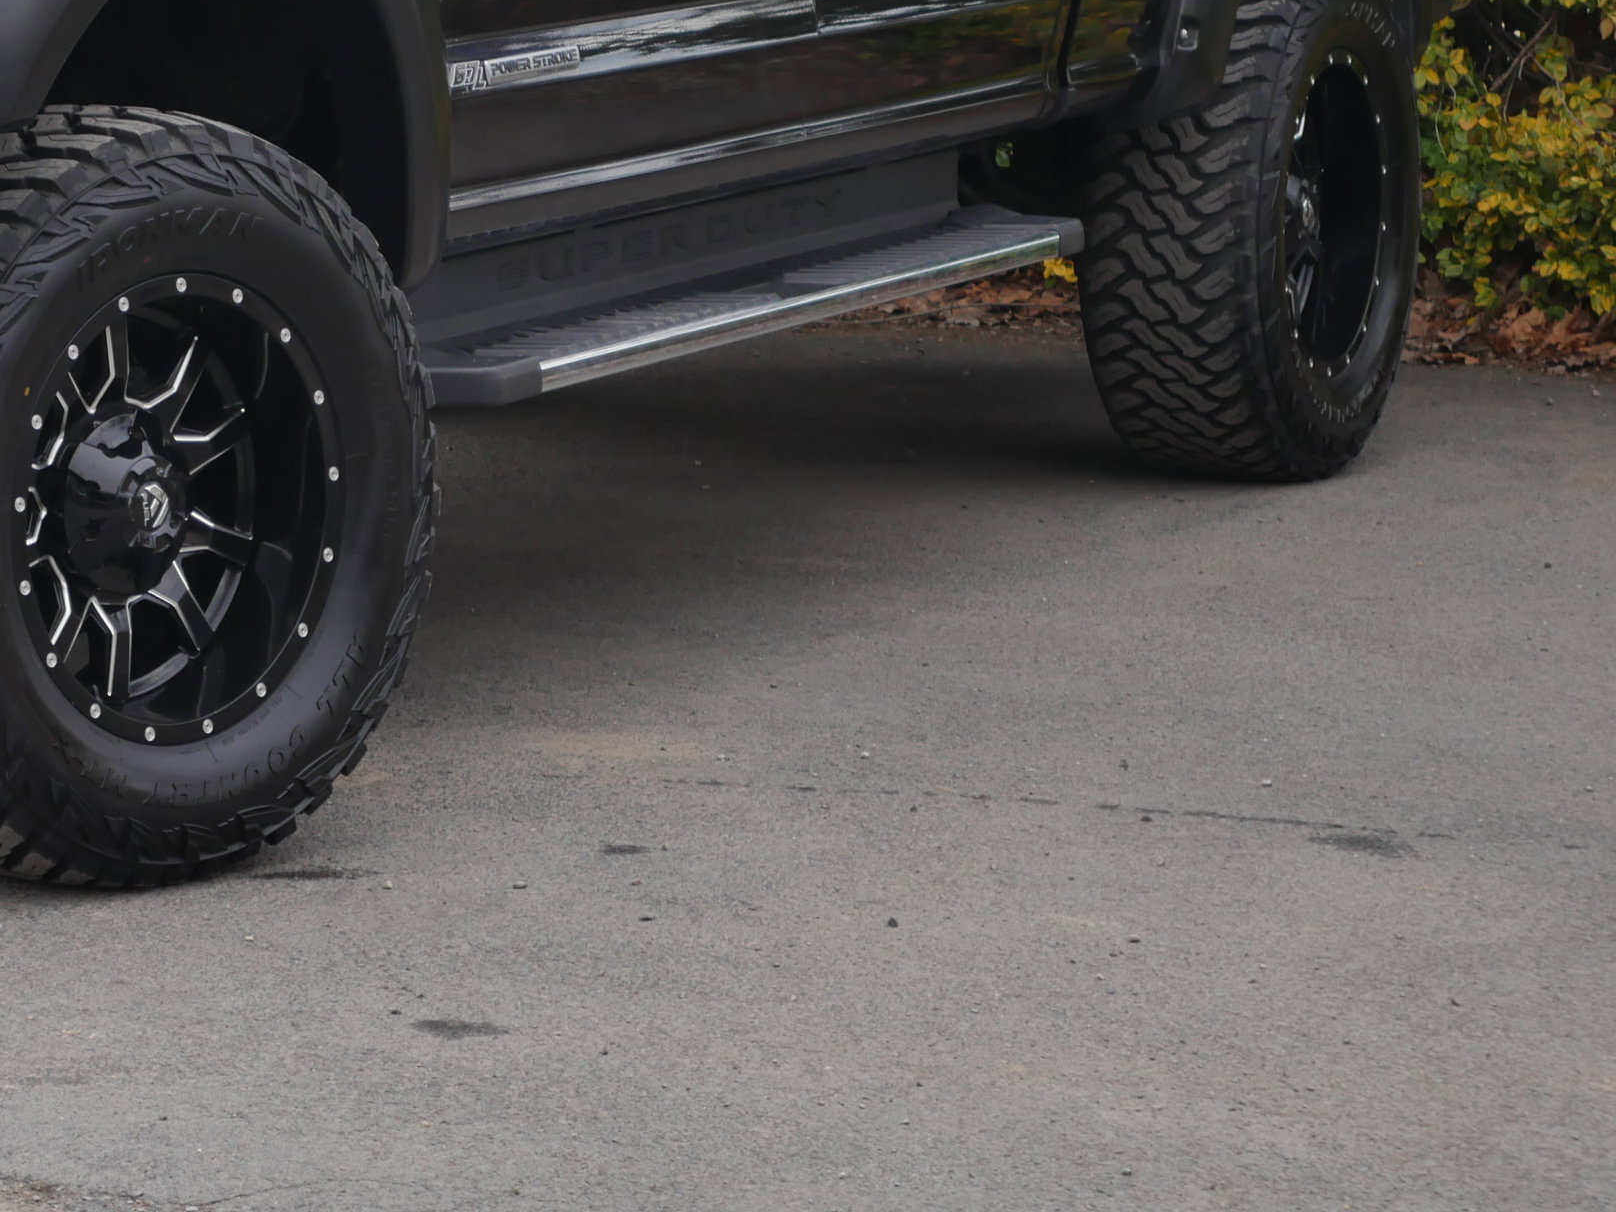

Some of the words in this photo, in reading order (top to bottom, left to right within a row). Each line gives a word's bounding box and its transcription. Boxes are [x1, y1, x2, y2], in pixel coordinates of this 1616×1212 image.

[491, 58, 532, 76] POWER
[533, 49, 578, 69] STROKE
[497, 223, 690, 293] SUPER
[707, 187, 844, 245] DUTY
